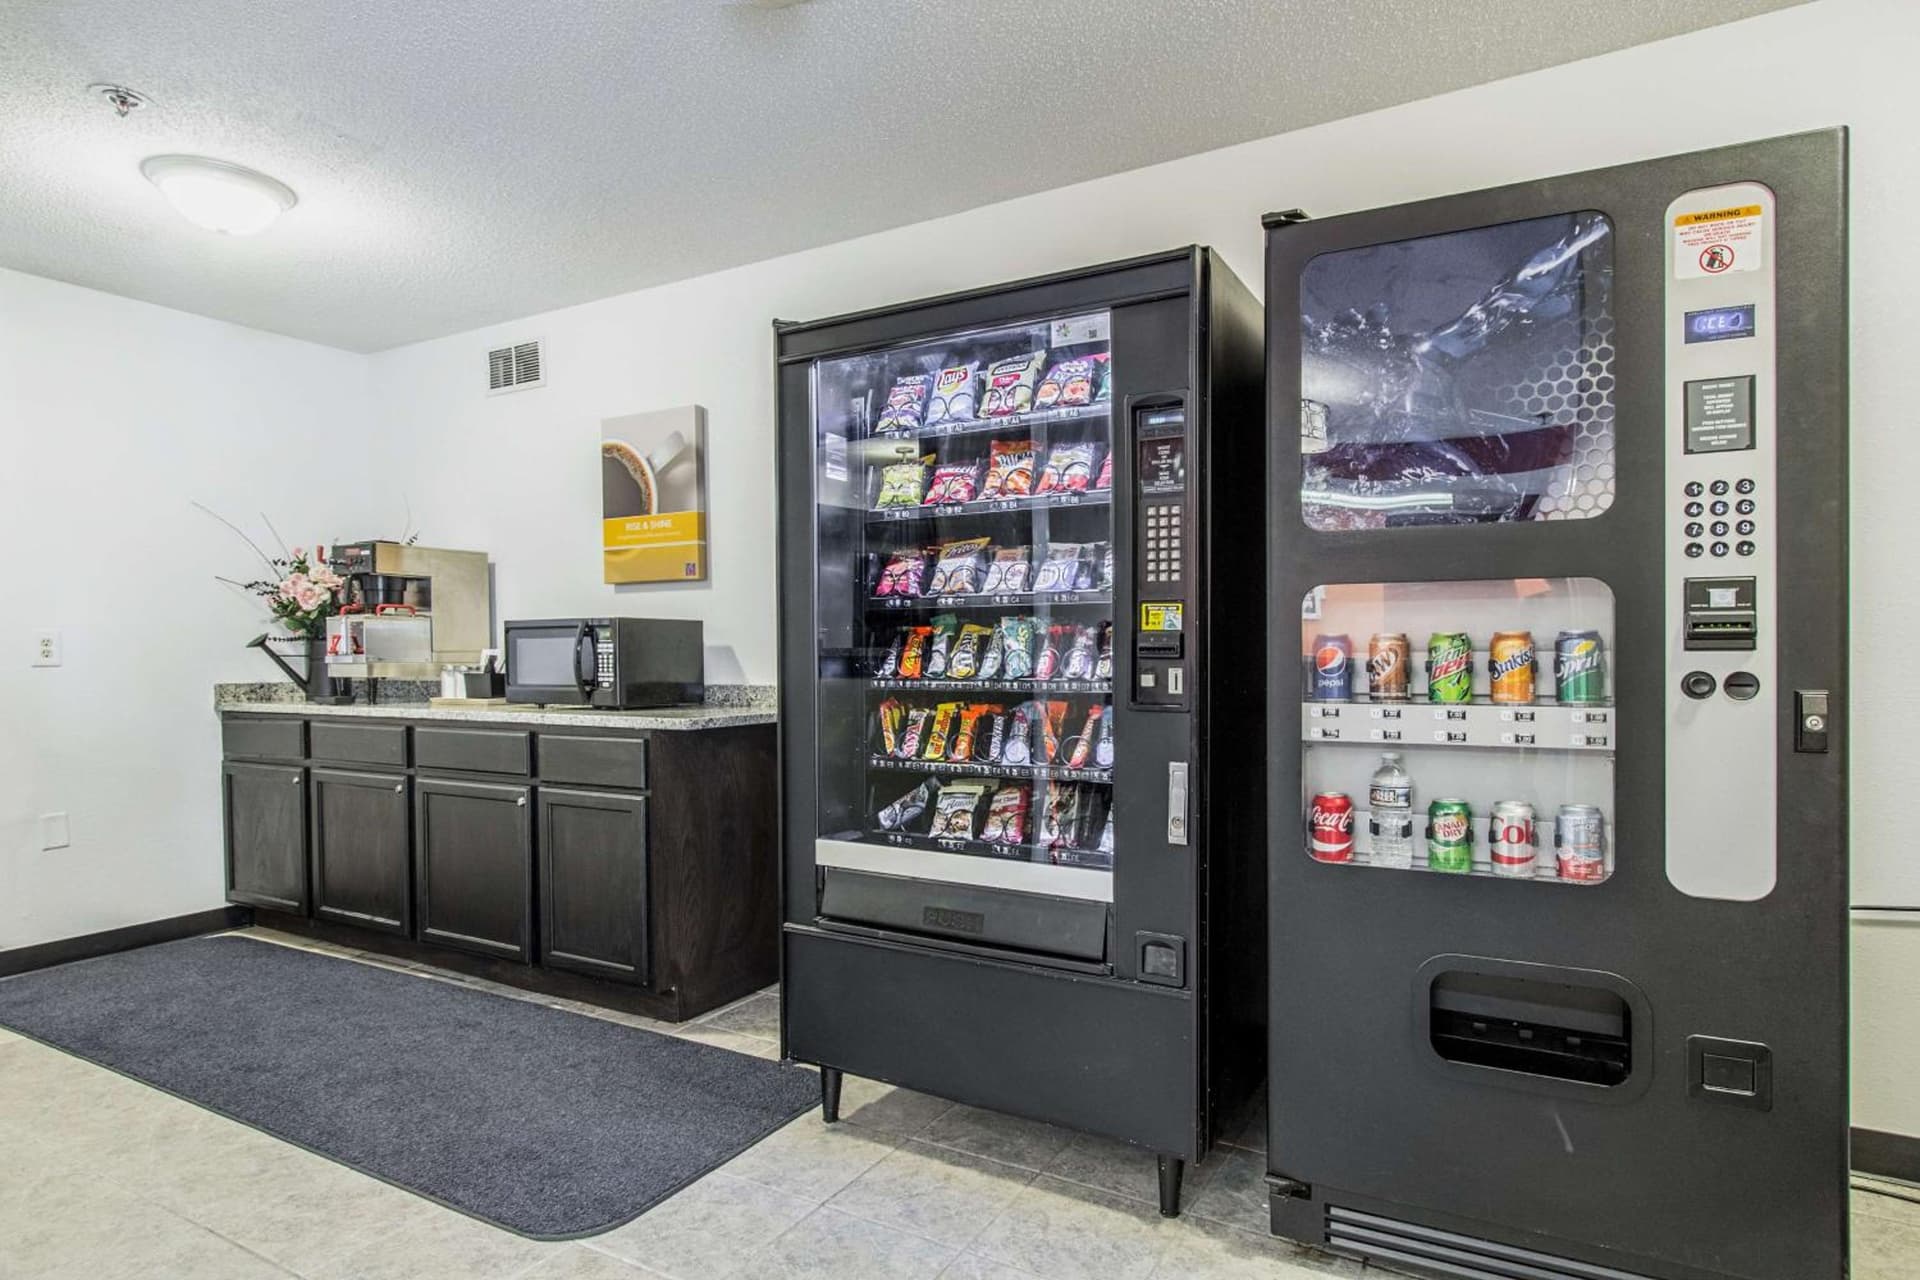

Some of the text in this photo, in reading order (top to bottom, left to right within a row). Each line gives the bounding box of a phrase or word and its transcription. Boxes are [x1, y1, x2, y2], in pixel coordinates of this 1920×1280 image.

[1694, 208, 1741, 222] WARNING
[1691, 481, 1751, 494] 1 2 3
[1690, 501, 1750, 514] 4 5 6
[1691, 522, 1750, 535] 7 8 9
[1716, 543, 1723, 554] 0
[1556, 649, 1600, 679] Sprit
[1318, 679, 1344, 689] pepsi
